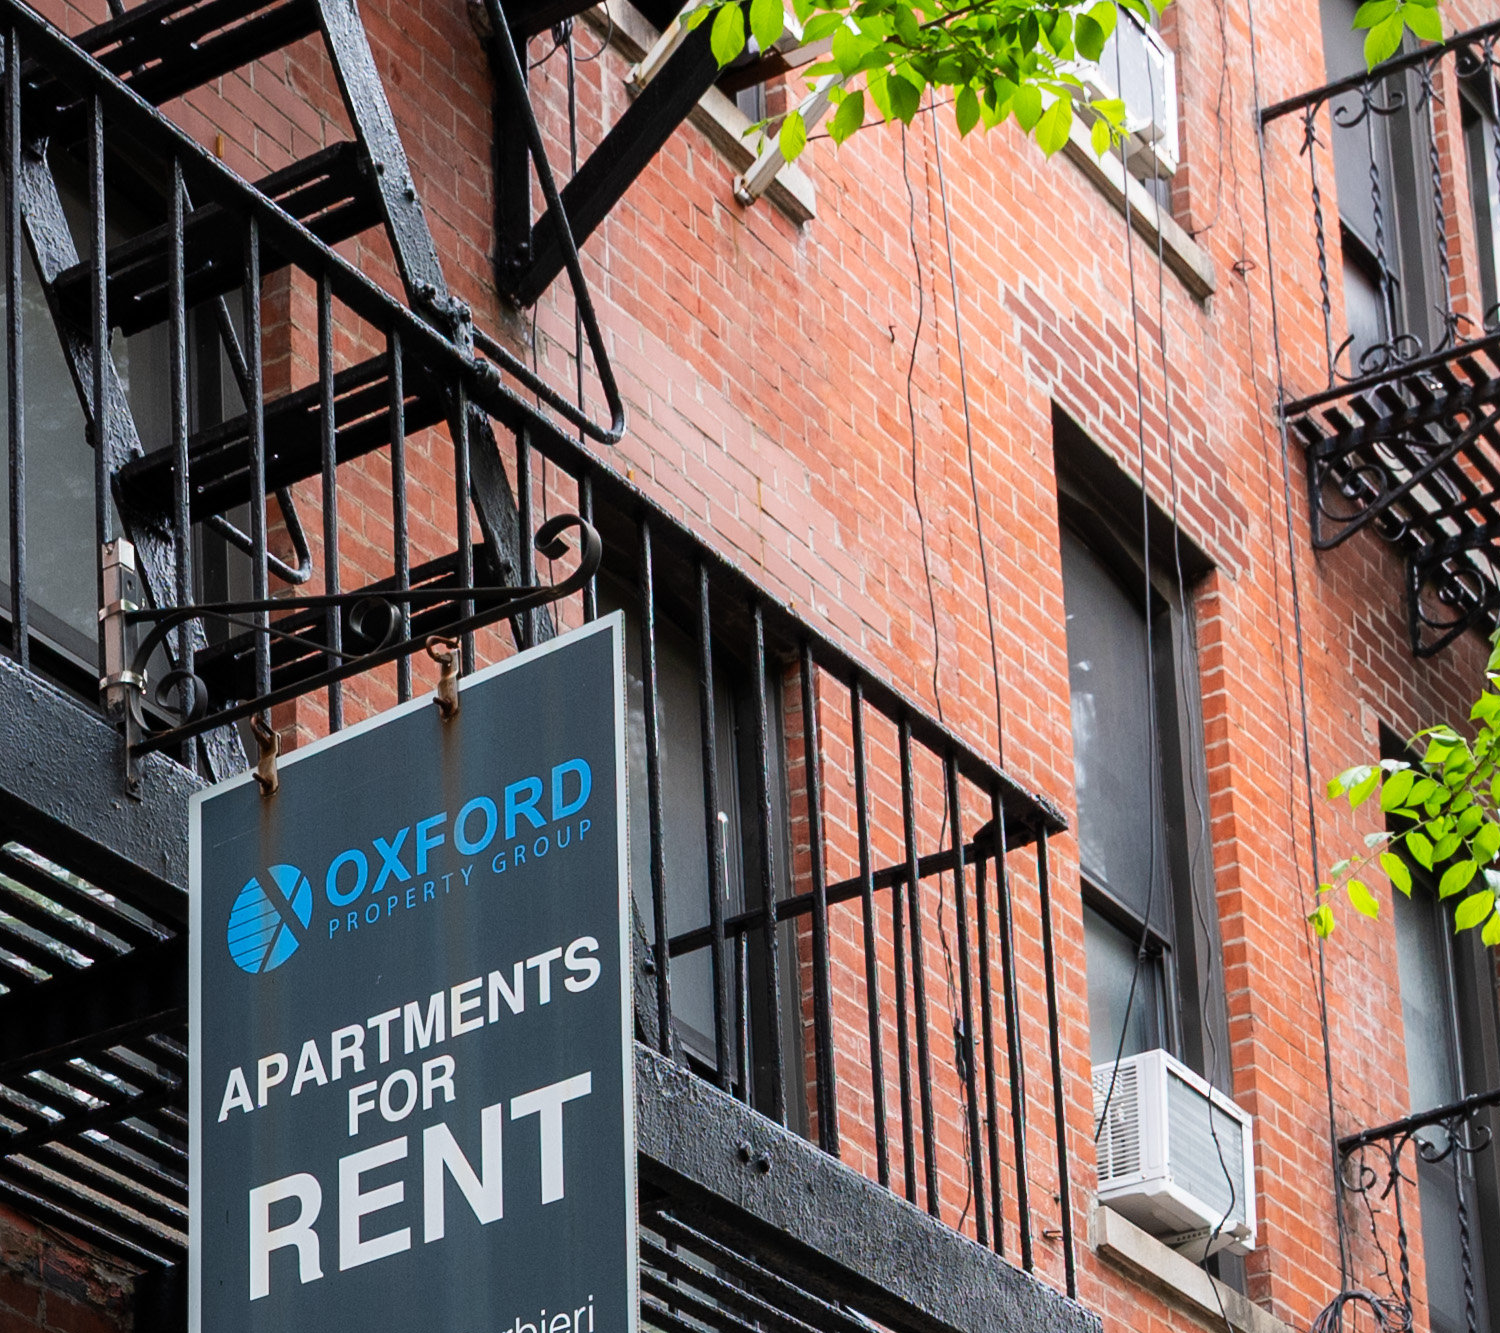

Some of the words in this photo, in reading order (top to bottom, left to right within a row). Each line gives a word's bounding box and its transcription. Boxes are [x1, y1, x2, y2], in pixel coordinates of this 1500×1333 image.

[326, 757, 593, 907] OXFORD
[329, 865, 472, 940] PROPERTY
[492, 819, 593, 875] GROUP
[218, 936, 601, 1122] APARTMENTS
[348, 1055, 456, 1137] FOR
[249, 1071, 592, 1301] RENT
